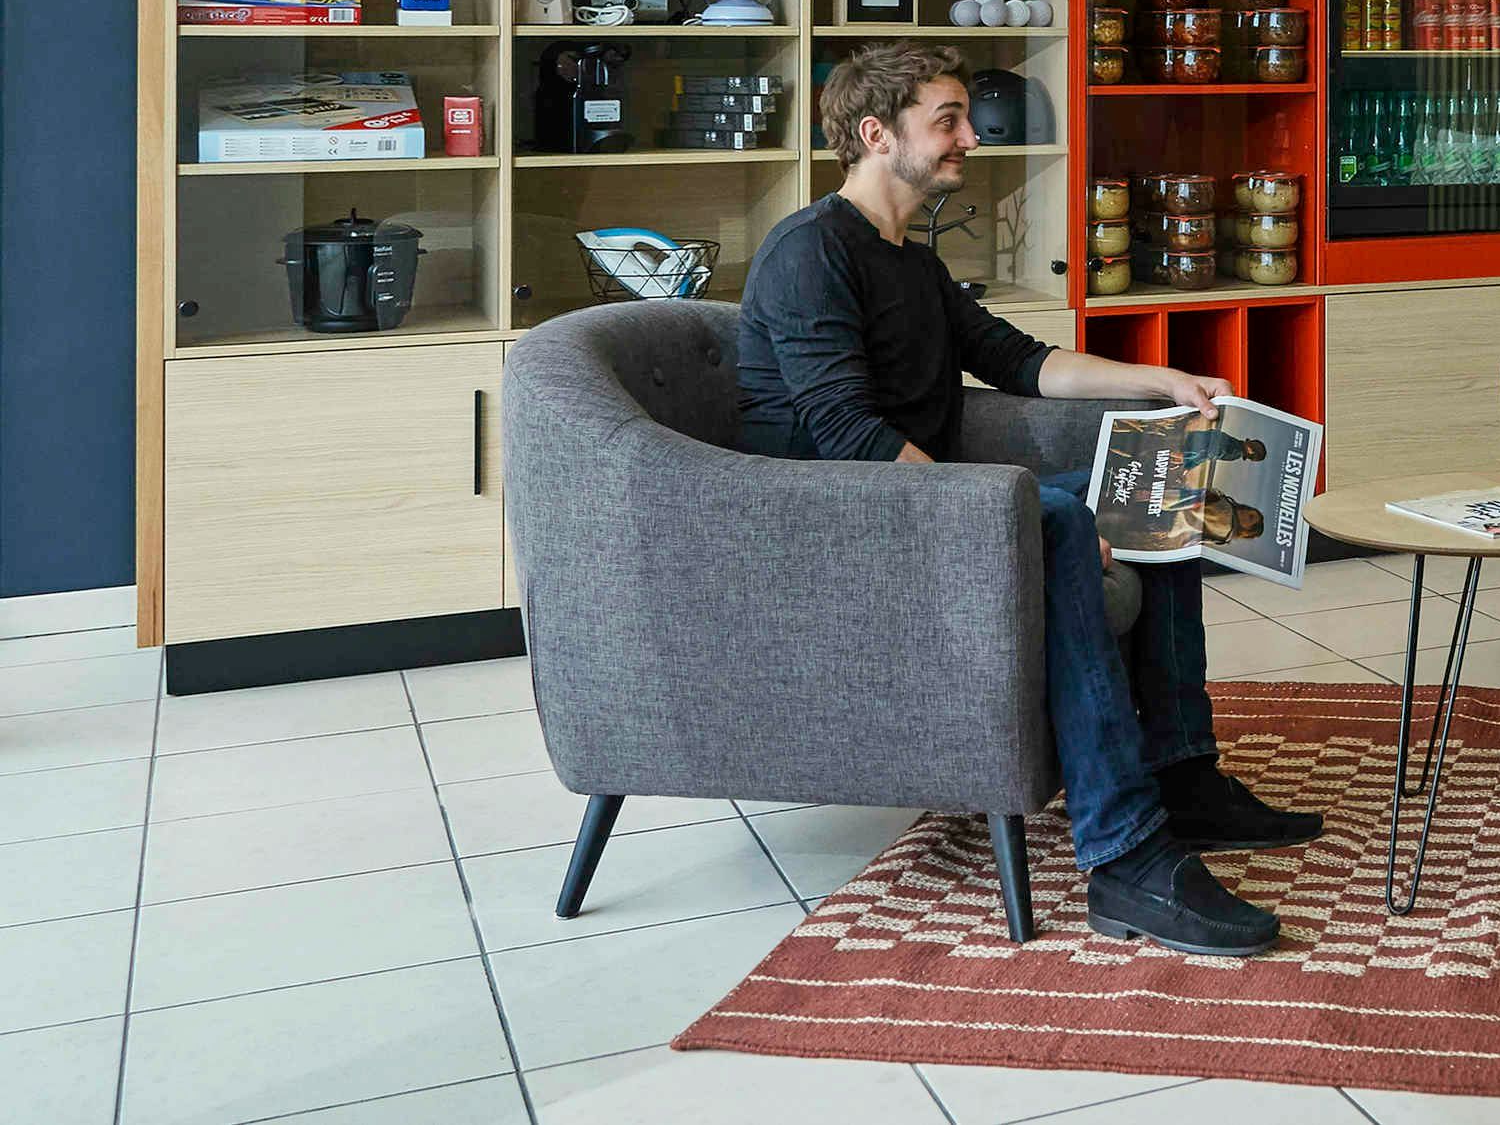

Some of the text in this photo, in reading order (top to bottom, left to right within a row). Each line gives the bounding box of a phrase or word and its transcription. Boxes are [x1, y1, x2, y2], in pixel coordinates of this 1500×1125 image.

[1154, 449, 1171, 479] HAPPY
[1284, 450, 1304, 475] LES
[1276, 475, 1301, 548] NOUVELLES
